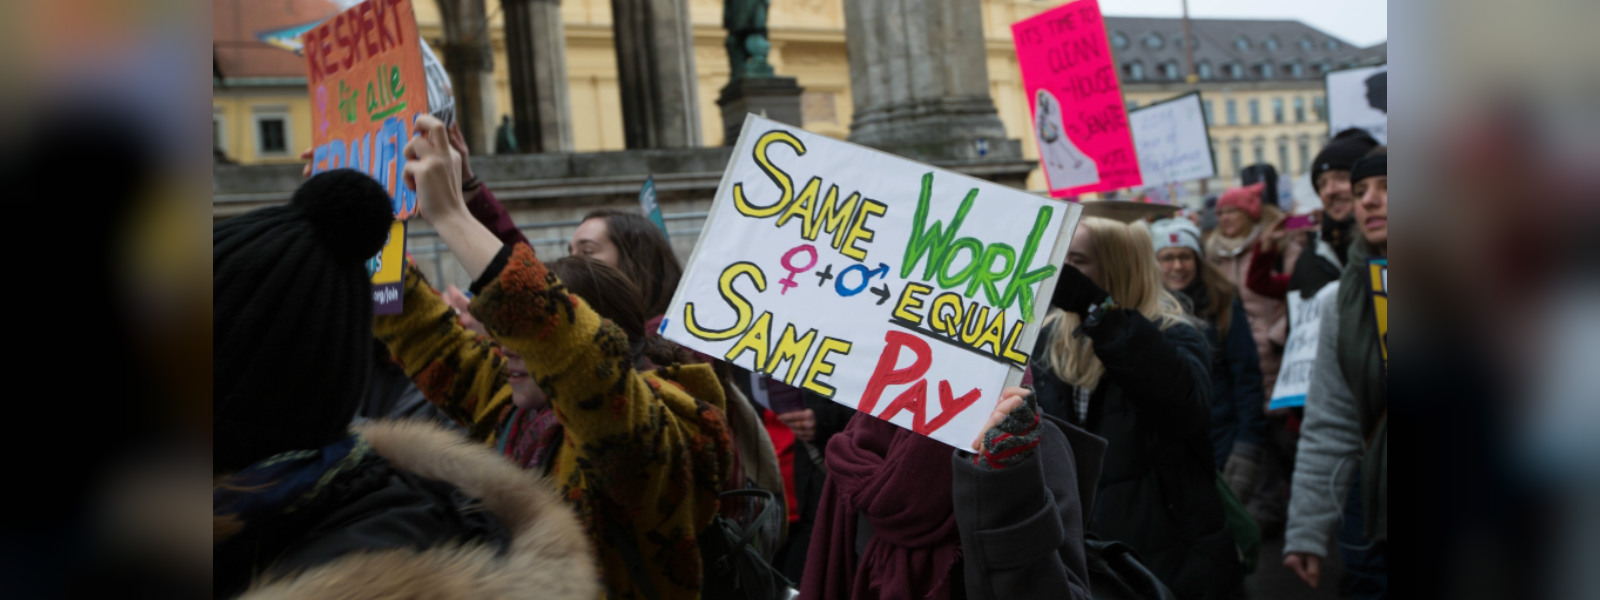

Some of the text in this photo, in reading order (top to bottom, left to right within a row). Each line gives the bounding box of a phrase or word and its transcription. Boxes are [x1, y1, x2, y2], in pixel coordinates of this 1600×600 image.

[306, 0, 403, 85] RESPEKT
[1047, 12, 1076, 35] TIME
[1079, 5, 1098, 24] TO
[1047, 32, 1101, 74] CLEAN
[366, 62, 406, 115] alle
[732, 130, 1058, 323] SAME WORK
[684, 261, 983, 437] SAME PAY
[891, 281, 1031, 366] EQUAL
